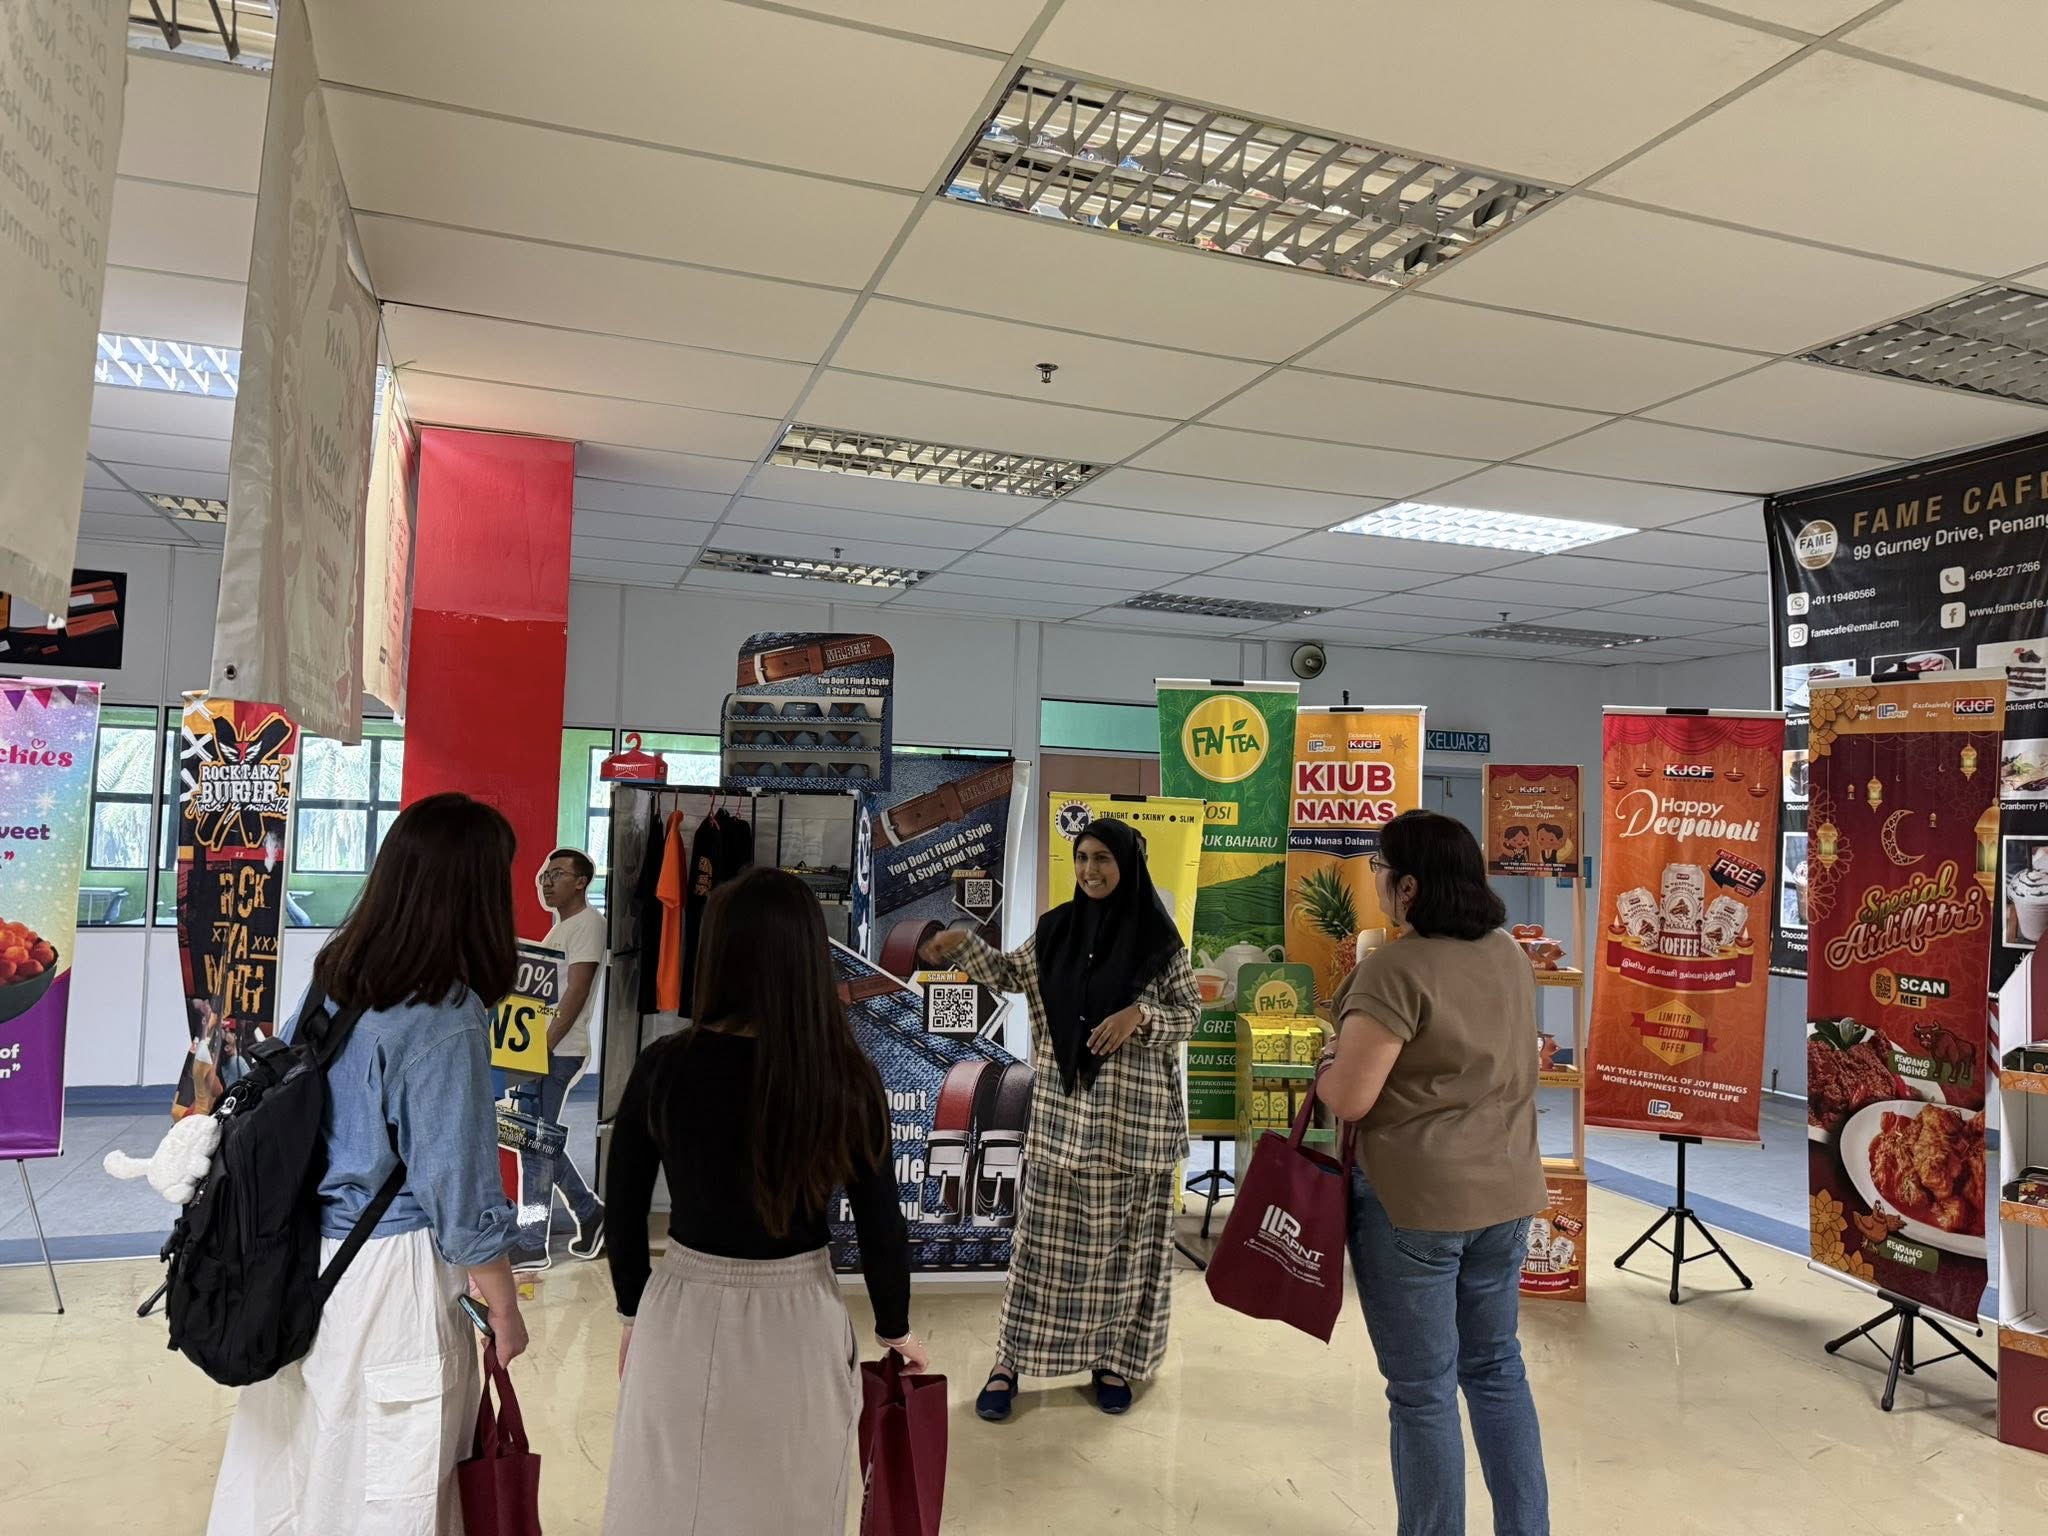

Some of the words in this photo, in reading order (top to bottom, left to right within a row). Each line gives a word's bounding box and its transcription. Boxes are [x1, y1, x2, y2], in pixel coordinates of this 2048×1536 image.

[1853, 495, 1942, 537] FAME
[1800, 534, 1832, 549] FAME
[1854, 545, 1871, 561] 99
[1875, 535, 1930, 556] Gurney
[1935, 527, 1984, 545] Drive,
[2016, 561, 2041, 575] 7266
[1811, 620, 1899, 638] famecafe@email.com
[831, 677, 849, 685] Don't
[871, 678, 889, 686] Style
[832, 687, 850, 695] Style
[1956, 700, 1994, 712] KJCF
[2006, 702, 2036, 711] ckforest
[1225, 734, 1260, 754] TEA
[1350, 741, 1380, 749] KJCF
[1428, 732, 1476, 750] KELUAR
[1297, 763, 1393, 792] KIUB
[1666, 764, 1713, 776] KJCF
[201, 780, 279, 803] BURGER
[1204, 806, 1232, 820] OSI
[1296, 801, 1394, 822] NANAS
[1662, 797, 1724, 818] Happy
[2000, 802, 2038, 812] Cranberry
[1100, 811, 1128, 820] STRAIGHT
[1142, 813, 1165, 822] SKINNY
[1180, 815, 1195, 824] SLIM
[1615, 789, 1760, 842] Deepavali
[1203, 835, 1222, 846] UK
[1225, 835, 1278, 848] BAHARU
[1290, 836, 1312, 845] Kiub
[1315, 837, 1342, 845] Nanas
[1345, 837, 1373, 846] Dalam
[887, 861, 908, 876] You
[908, 846, 936, 867] Don't
[935, 837, 957, 856] Find
[957, 834, 966, 845] A
[966, 823, 993, 841] Style
[908, 872, 918, 884] A
[918, 861, 943, 880] Style
[943, 850, 966, 868] Find
[965, 843, 985, 856] You
[1714, 859, 1762, 888] FREE
[1861, 866, 1953, 926] Special
[1828, 891, 1979, 966] Aidilfitri
[1660, 936, 1700, 957] COFFEE
[515, 963, 555, 997] 0%
[1900, 977, 1945, 994] SCAN
[1276, 999, 1294, 1009] TEA
[1900, 994, 1921, 1006] ME!
[1658, 1012, 1691, 1024] LIMITED
[1659, 1028, 1689, 1039] EDITION
[1660, 1042, 1685, 1053] OFFER
[1188, 1054, 1214, 1064] KAN
[1894, 1054, 1930, 1068] RENDANG
[1898, 1064, 1928, 1077] DAGING
[1597, 1064, 1617, 1073] MAY
[1618, 1067, 1637, 1077] THIS
[1638, 1070, 1678, 1083] FESTIVAL
[1680, 1077, 1692, 1085] OF
[1694, 1080, 1710, 1088] JOY
[1712, 1082, 1747, 1094] BRINGS
[1602, 1074, 1627, 1085] MORE
[1630, 1079, 1676, 1092] HAPPINESS
[1679, 1087, 1690, 1095] TO
[1692, 1089, 1717, 1100] YOUR
[1719, 1094, 1739, 1102] LIFE
[527, 1139, 541, 1150] FOR
[542, 1144, 555, 1155] YOU
[1555, 1215, 1582, 1232] FREE
[1281, 1233, 1325, 1262] APNT
[1886, 1240, 1923, 1258] RENDANG
[1893, 1252, 1916, 1266] AYAM
